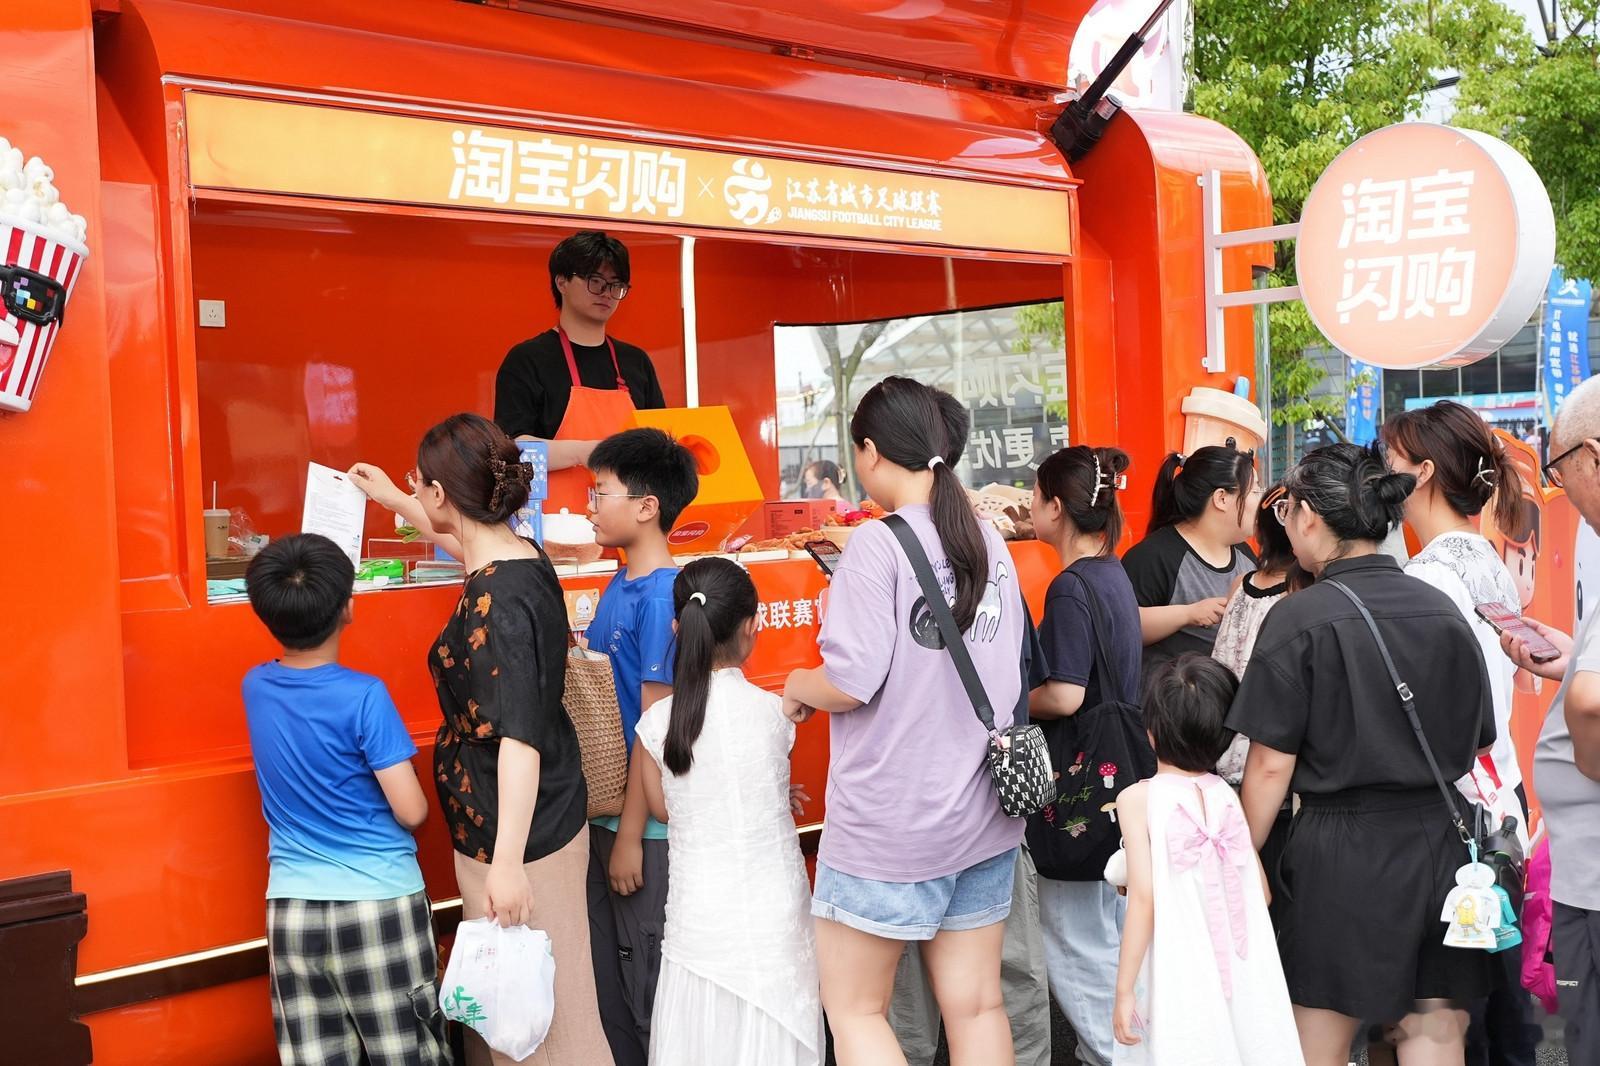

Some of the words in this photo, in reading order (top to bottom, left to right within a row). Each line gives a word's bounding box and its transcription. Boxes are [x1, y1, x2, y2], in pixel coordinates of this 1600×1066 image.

[448, 129, 687, 217] 淘宝闪购
[786, 177, 942, 217] 江苏省城市足球联赛
[1337, 168, 1475, 248] 淘宝
[787, 206, 831, 222] JIANGSU
[832, 210, 882, 226] FOOTBALL
[883, 214, 905, 228] CITY
[906, 217, 943, 231] LEAGUE
[1335, 247, 1476, 324] 闪购
